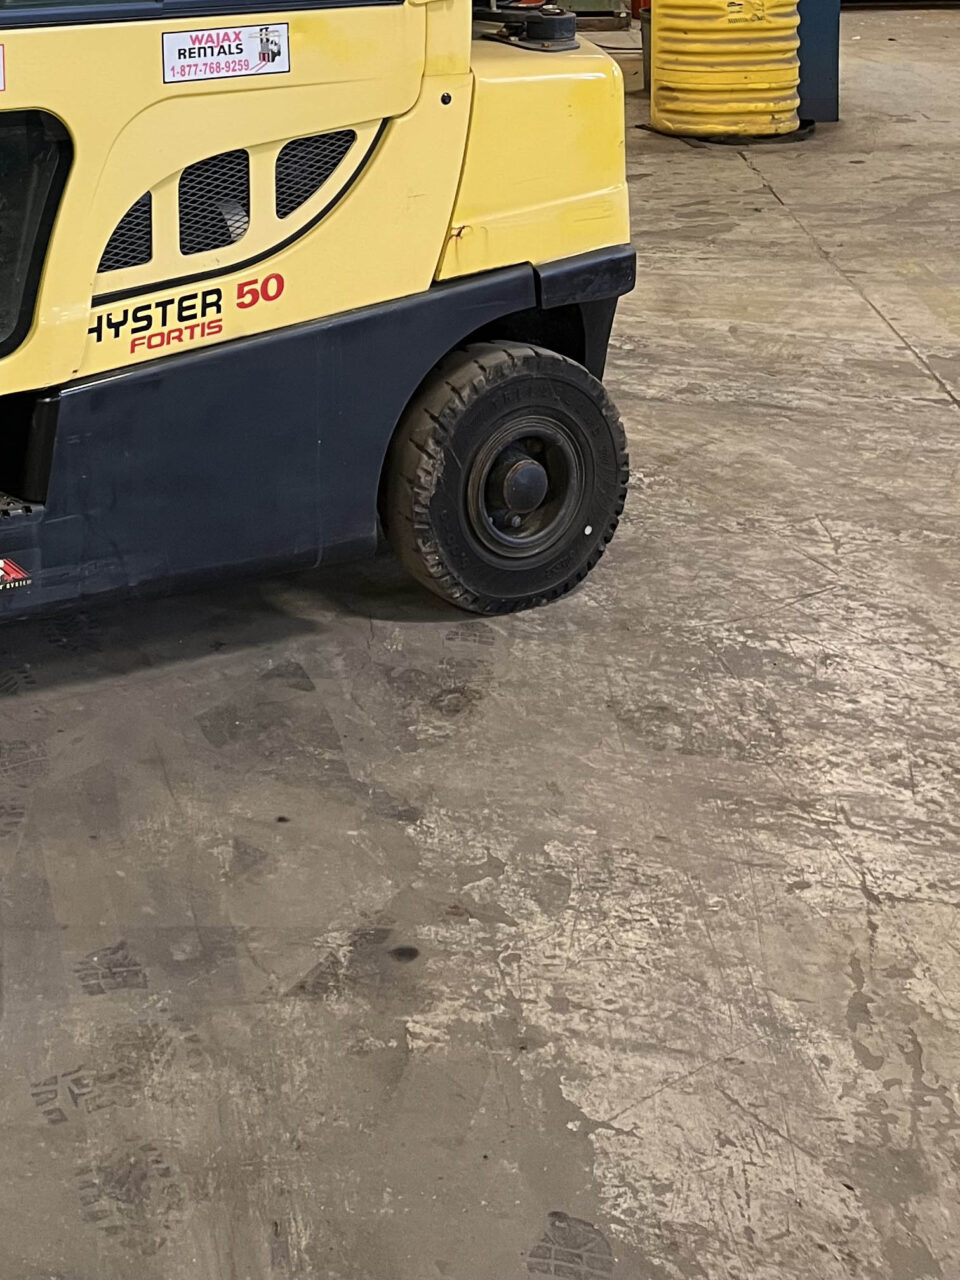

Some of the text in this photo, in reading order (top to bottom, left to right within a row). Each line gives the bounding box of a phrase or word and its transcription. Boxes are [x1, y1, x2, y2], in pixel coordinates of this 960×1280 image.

[189, 30, 243, 48] WAJAX
[177, 43, 244, 60] RENTALS
[170, 59, 250, 78] 1-877-768-9259
[87, 273, 285, 343] HYSTER 50
[130, 318, 223, 354] FORTIS
